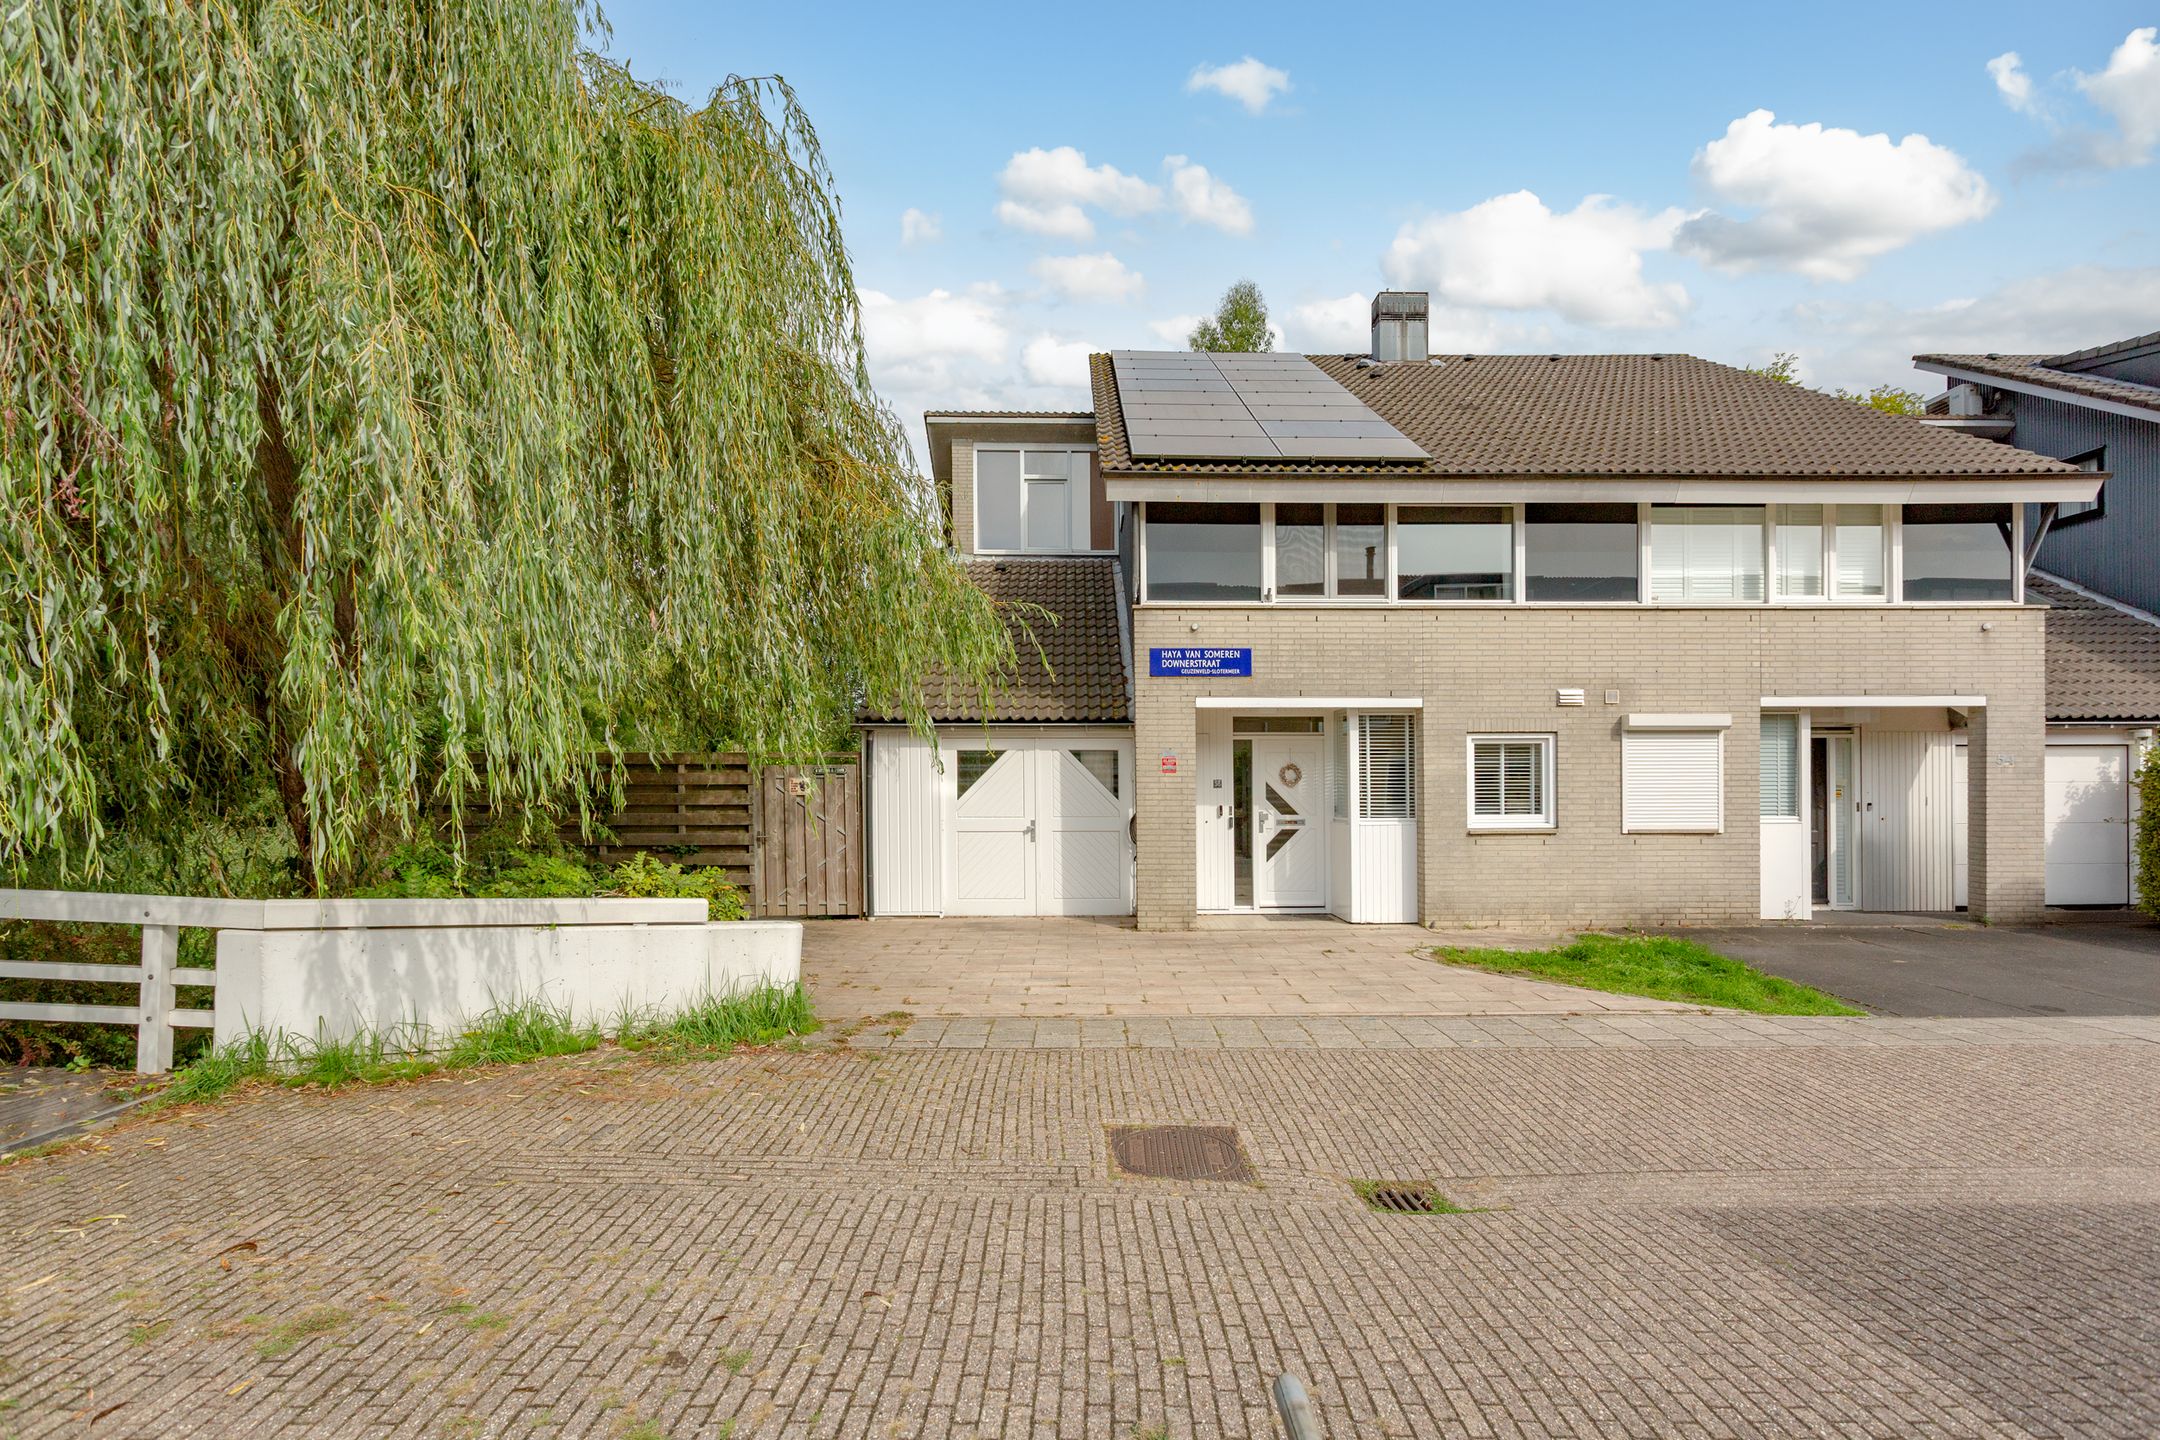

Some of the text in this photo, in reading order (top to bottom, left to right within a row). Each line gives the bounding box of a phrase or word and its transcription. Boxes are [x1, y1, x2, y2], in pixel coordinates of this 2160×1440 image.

[1161, 650, 1240, 658] HAYA VAN SOMEREN
[1161, 659, 1221, 667] DOWNERSTRAAT
